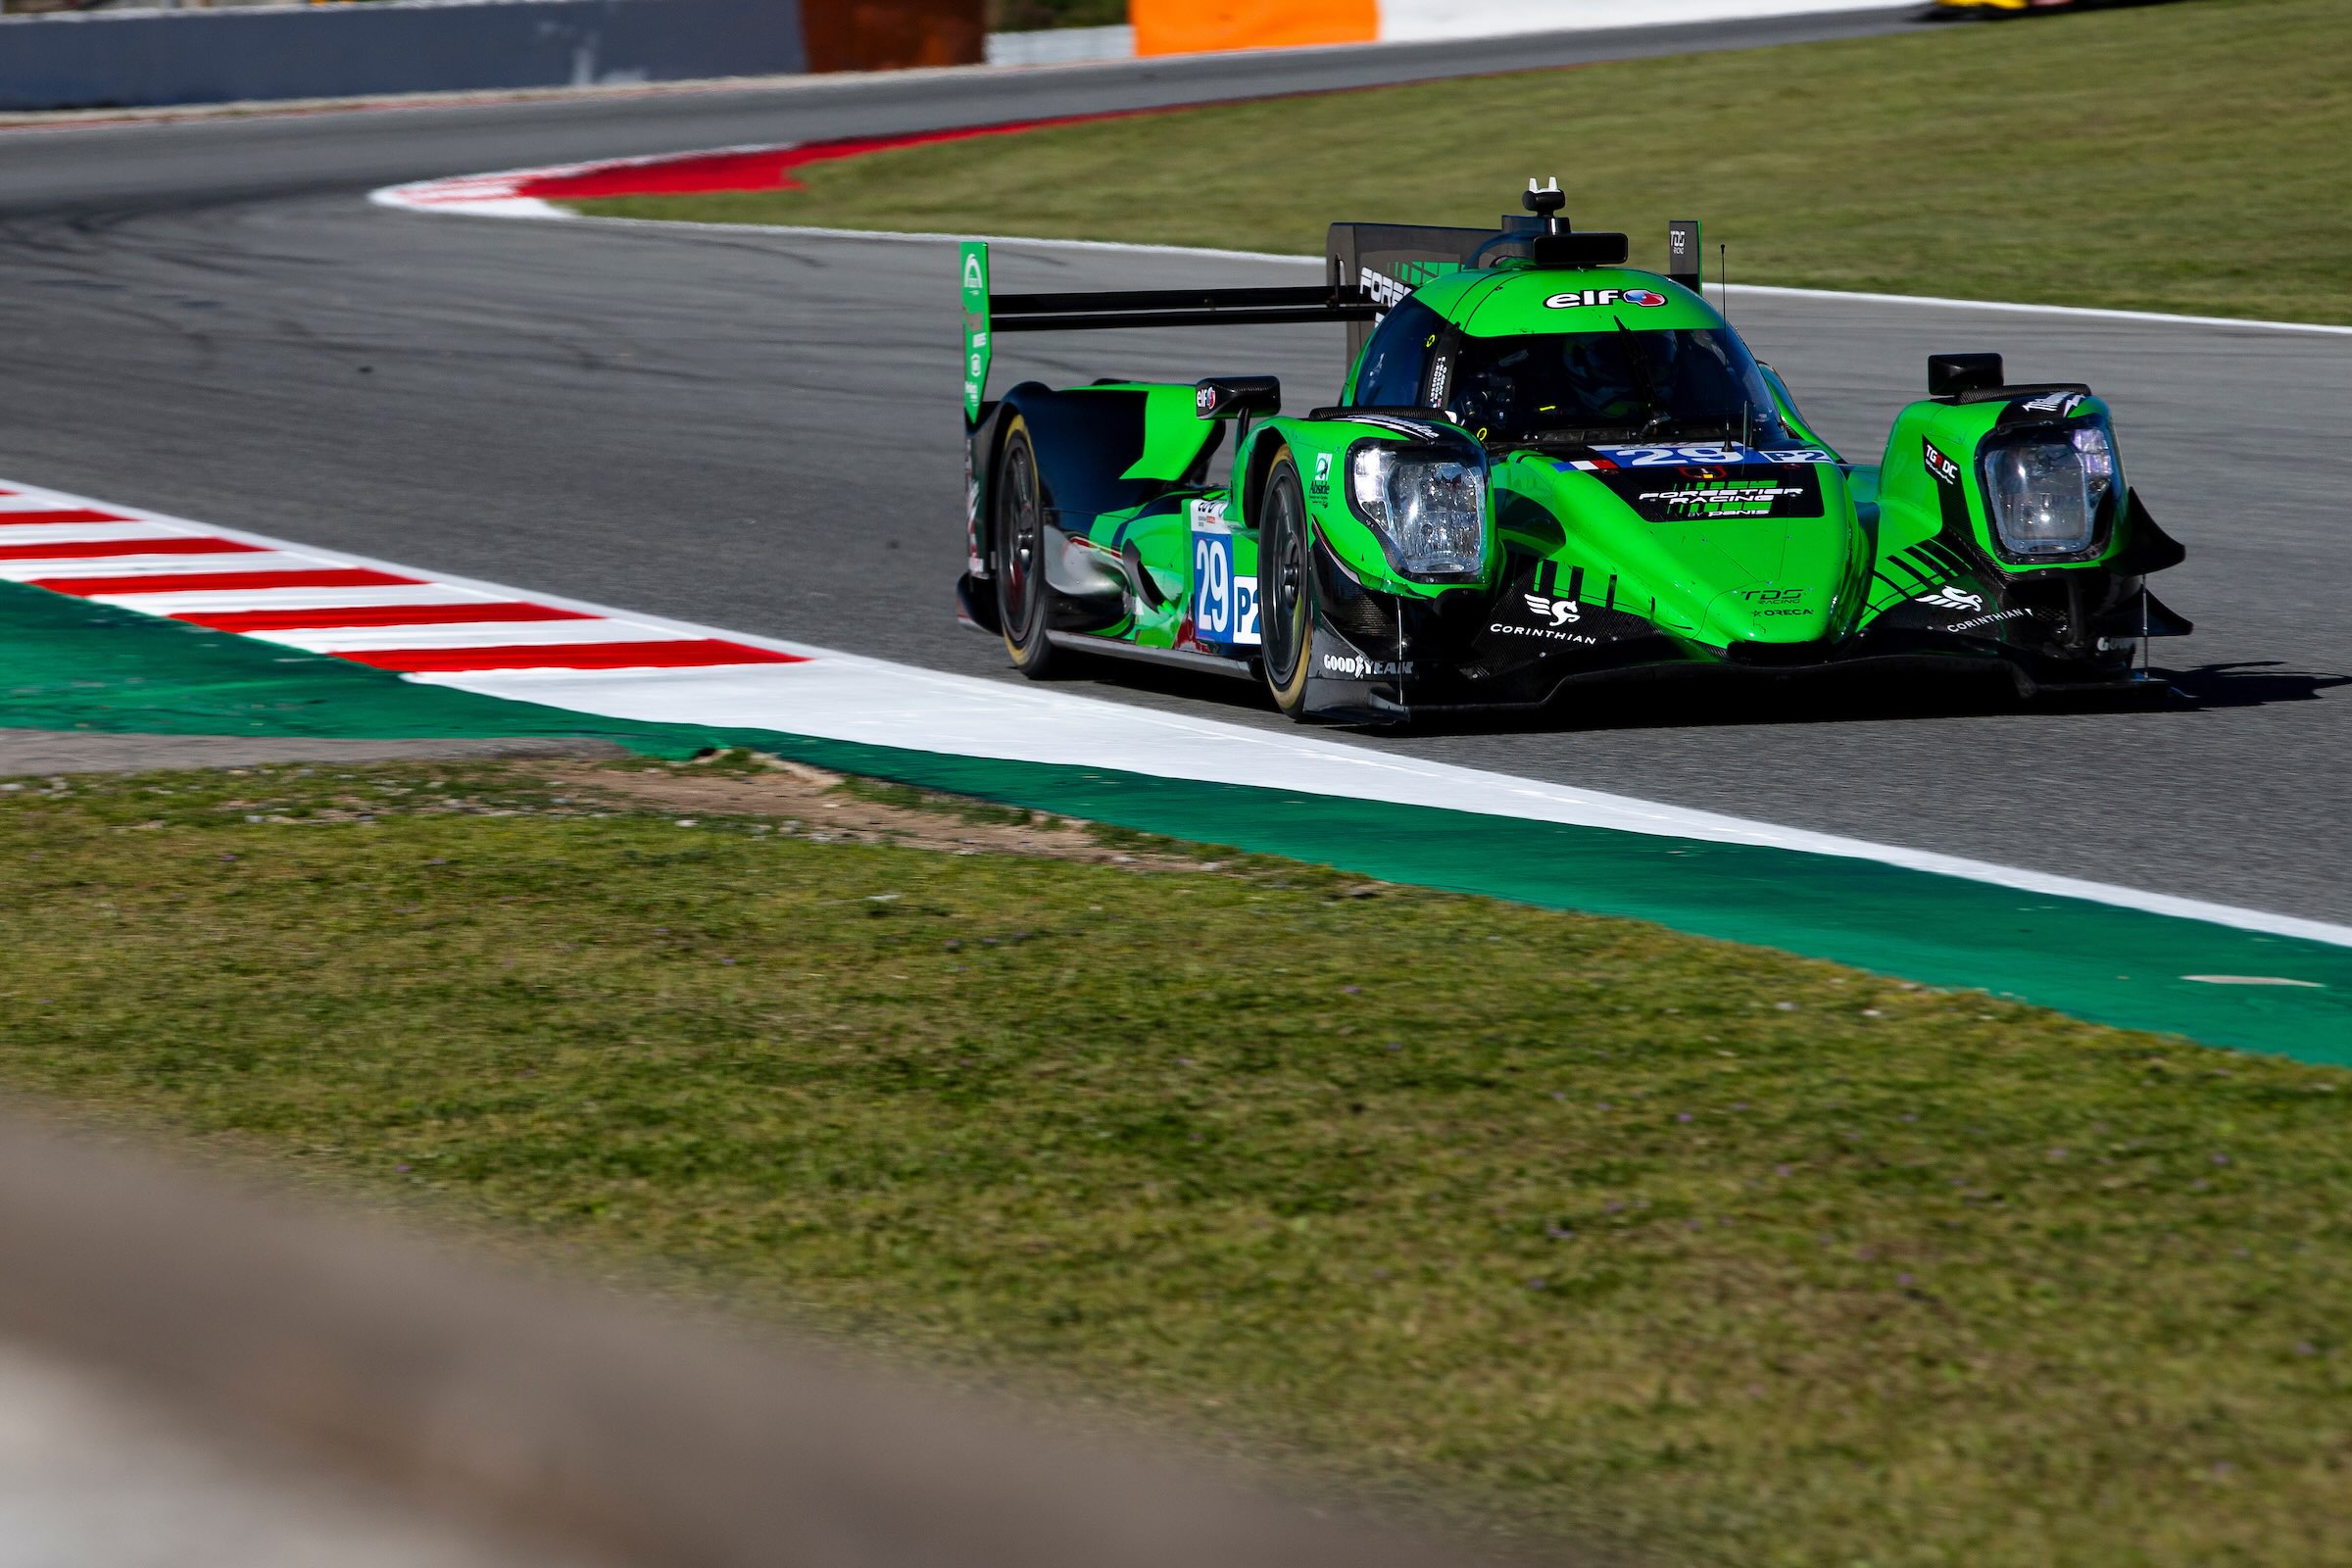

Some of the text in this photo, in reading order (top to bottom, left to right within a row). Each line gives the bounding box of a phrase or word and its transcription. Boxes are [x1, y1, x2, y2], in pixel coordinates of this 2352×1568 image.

[1545, 289, 1619, 308] elf
[1197, 389, 1207, 408] elf
[1616, 447, 1744, 466] 29
[1769, 450, 1832, 463] P2
[1926, 444, 1943, 467] TGR
[1942, 460, 1958, 479] DC
[1639, 488, 1804, 501] FORESTIER
[1669, 494, 1775, 505] RACING
[1196, 540, 1229, 633] 29
[1741, 589, 1804, 601] TDS
[1946, 608, 2025, 633] CORINTHIAN
[1490, 623, 1596, 645] CORINTHIAN
[1323, 654, 1414, 677] GOODYEAR
